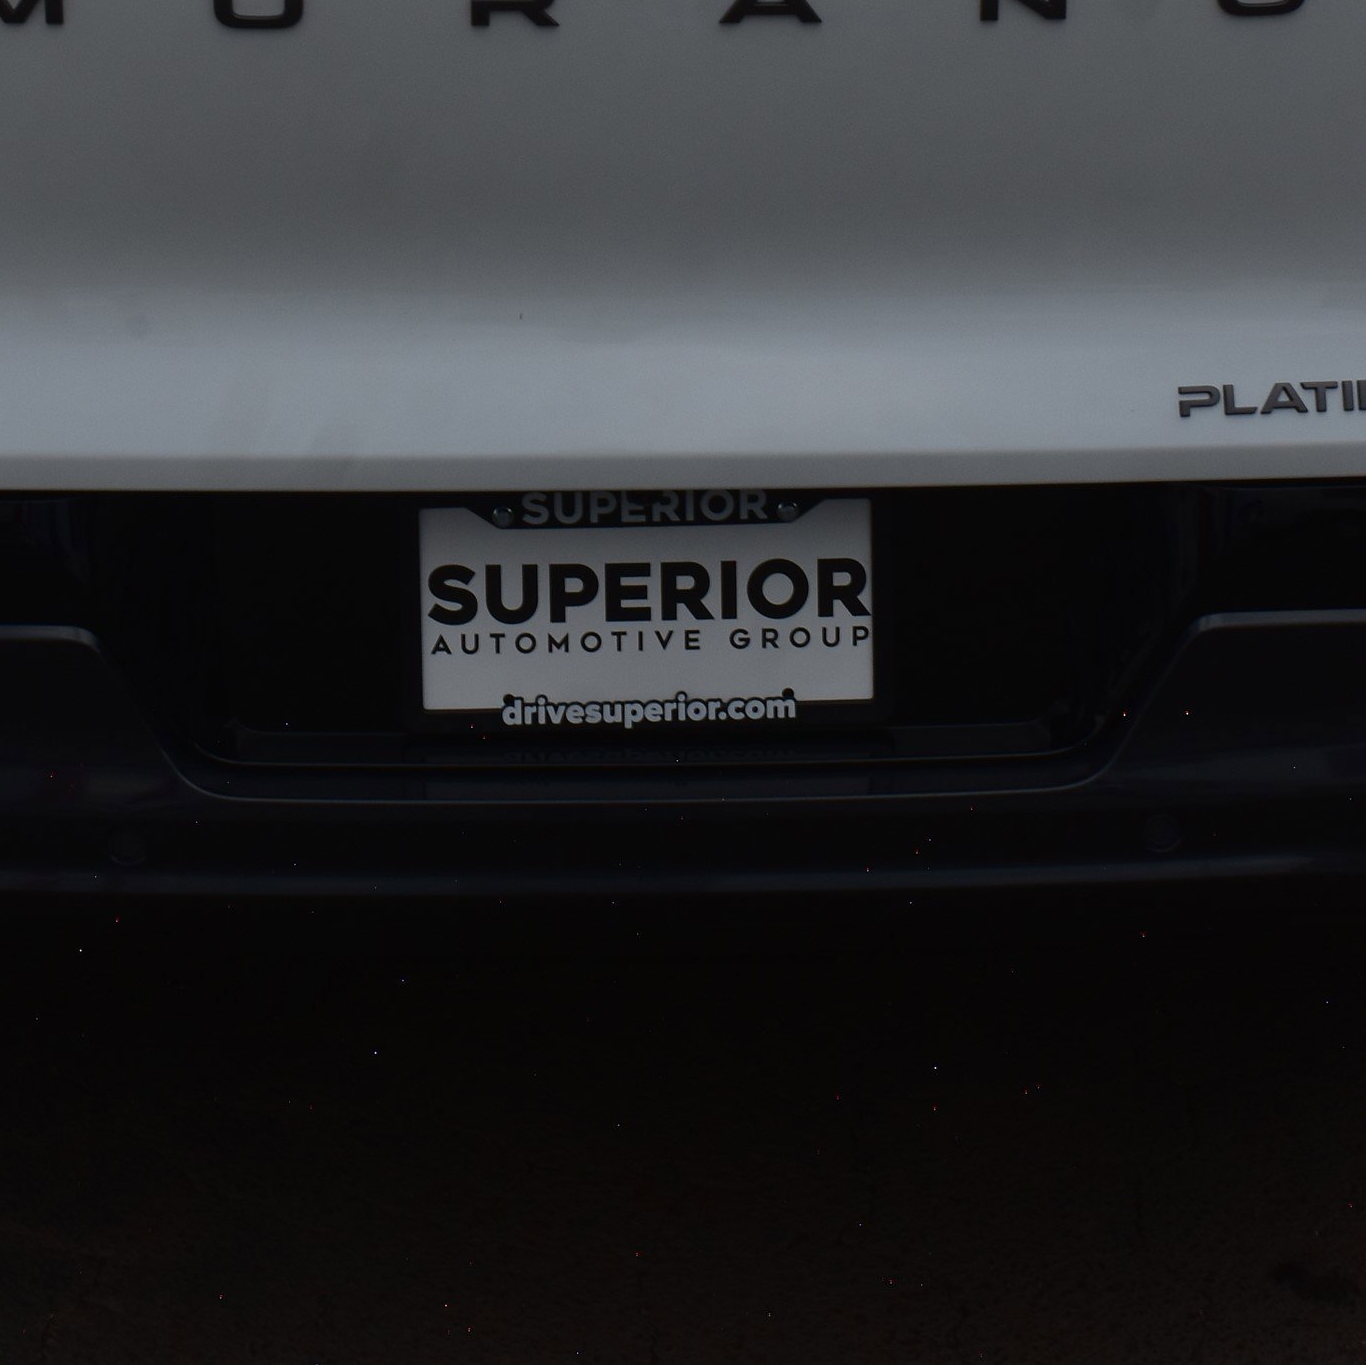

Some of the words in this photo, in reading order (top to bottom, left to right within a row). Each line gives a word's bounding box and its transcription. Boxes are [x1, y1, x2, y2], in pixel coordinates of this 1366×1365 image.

[522, 489, 769, 525] SUPERIOR
[427, 558, 872, 625] SUPERIOR
[431, 629, 702, 655] AUTOMOTIVE
[729, 625, 871, 650] GROUP
[502, 693, 797, 728] drivesuperior.com
